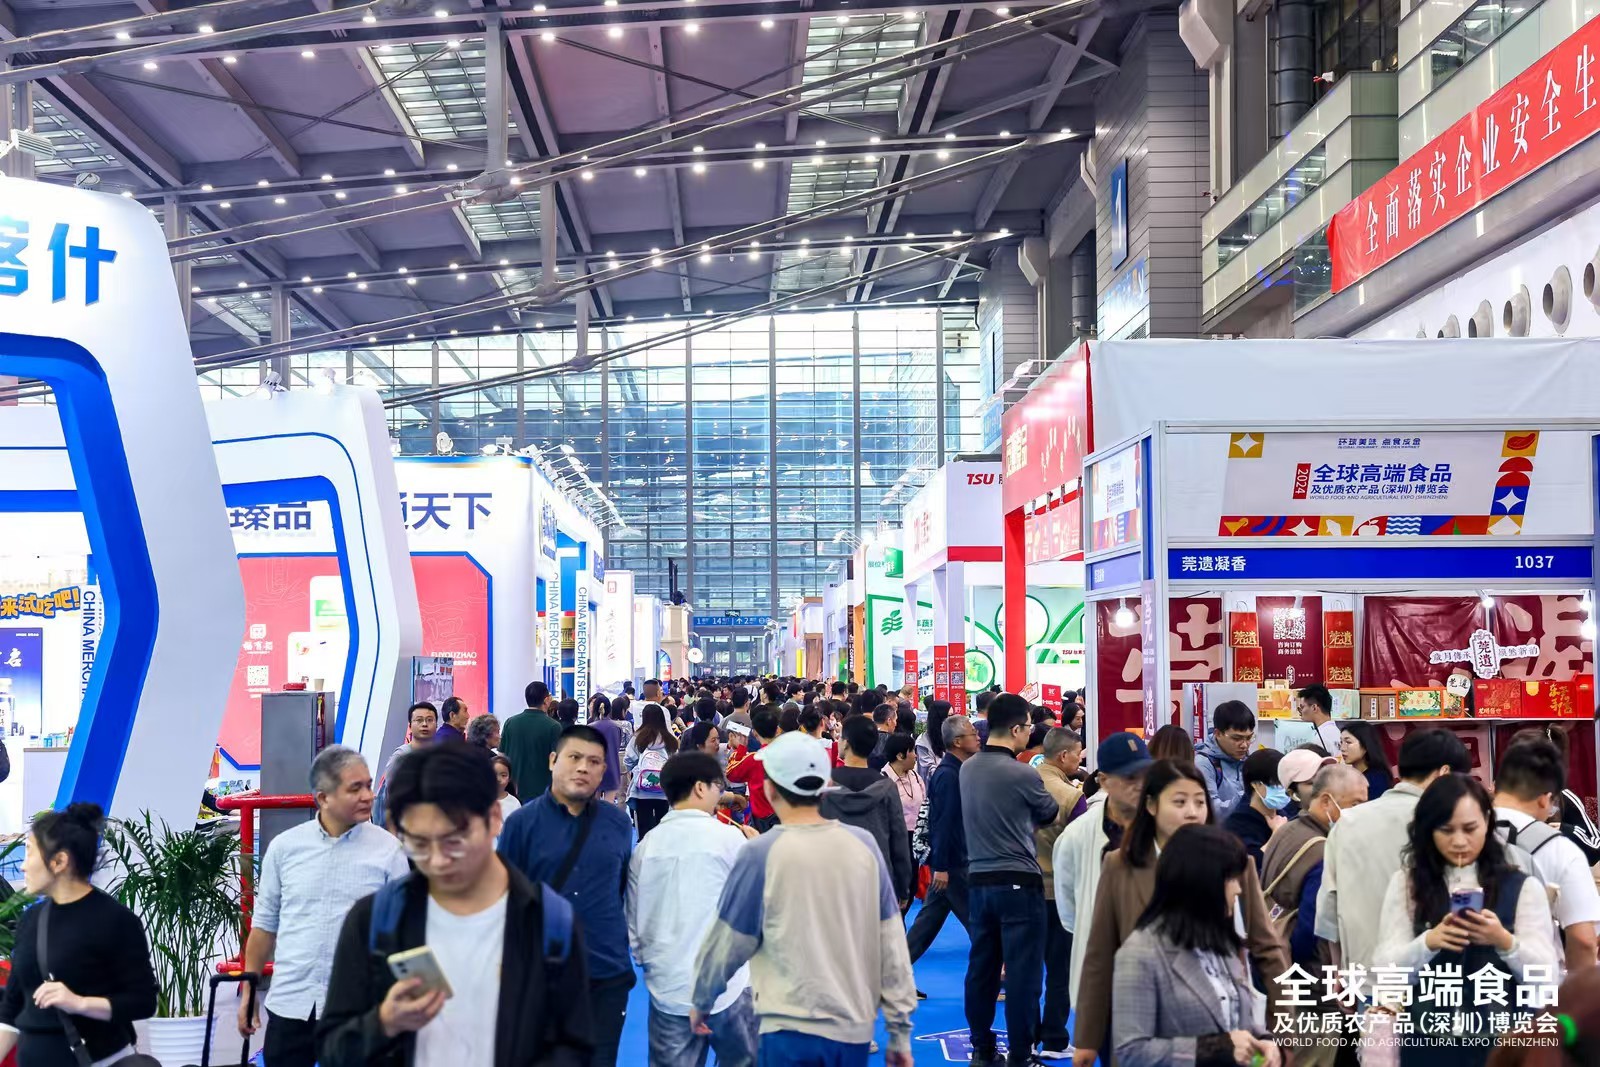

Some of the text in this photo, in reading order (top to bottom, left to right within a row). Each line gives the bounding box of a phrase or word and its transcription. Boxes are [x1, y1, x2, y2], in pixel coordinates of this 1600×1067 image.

[967, 473, 994, 485] TSU
[1295, 468, 1309, 495] 2024
[1313, 464, 1452, 483] 全球高端食品
[1181, 555, 1555, 572] 莞遗凝香 1037
[82, 591, 96, 637] CHINA
[577, 586, 588, 620] CHINA
[576, 621, 588, 686] MERCHANTS
